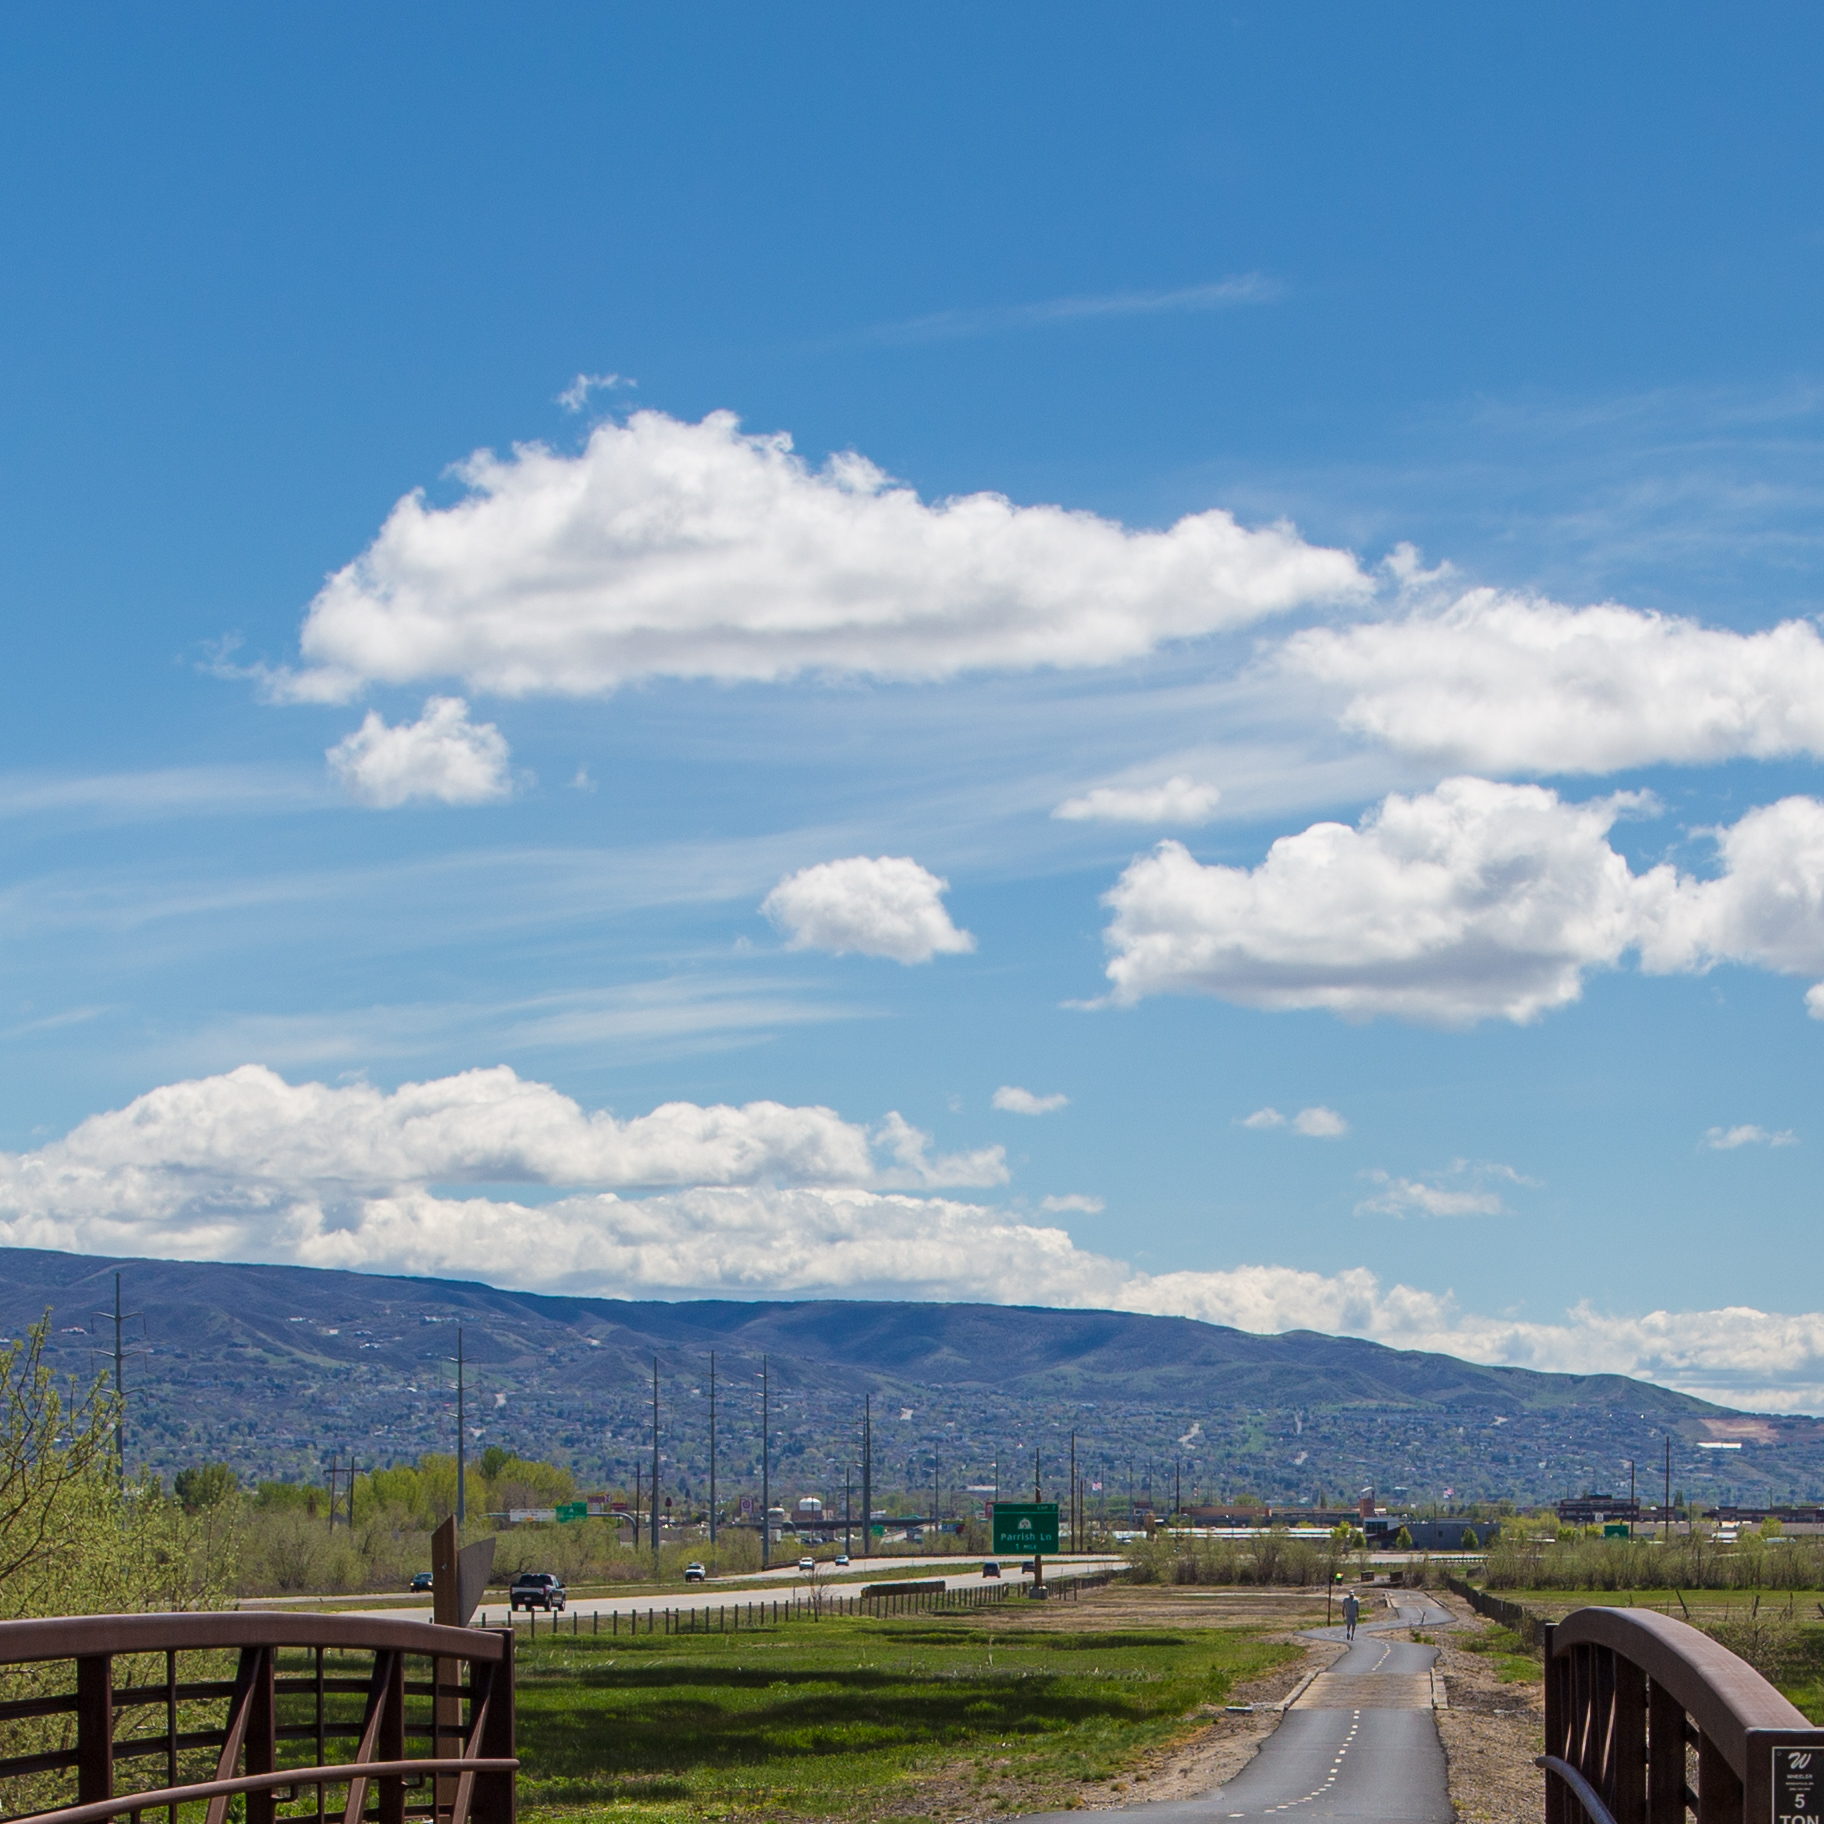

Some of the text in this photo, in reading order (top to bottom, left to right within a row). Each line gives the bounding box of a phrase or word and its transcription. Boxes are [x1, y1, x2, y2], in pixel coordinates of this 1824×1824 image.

[1000, 1532, 1052, 1541] Parrish Ln
[1794, 1793, 1805, 1809] 5
